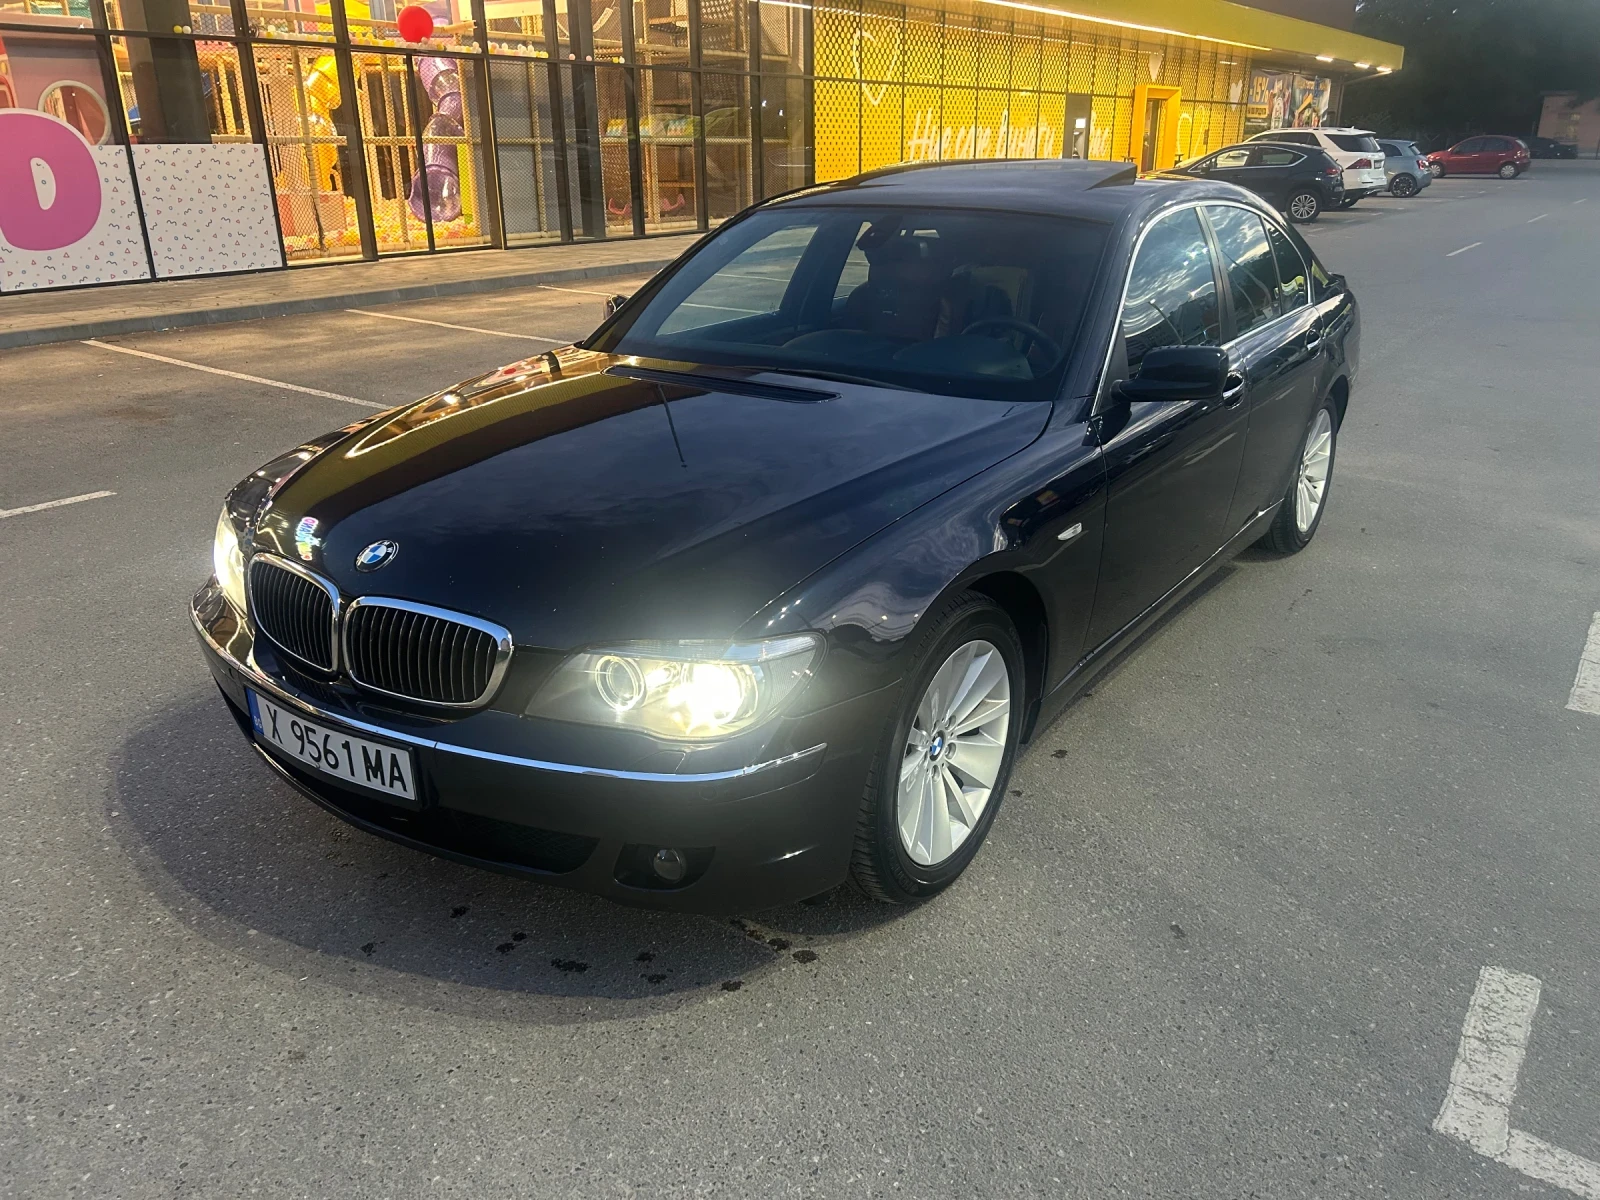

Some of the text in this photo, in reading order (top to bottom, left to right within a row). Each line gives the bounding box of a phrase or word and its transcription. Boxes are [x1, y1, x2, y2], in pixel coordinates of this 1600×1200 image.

[254, 715, 262, 729] BG
[266, 704, 408, 792] X 9561 MA
